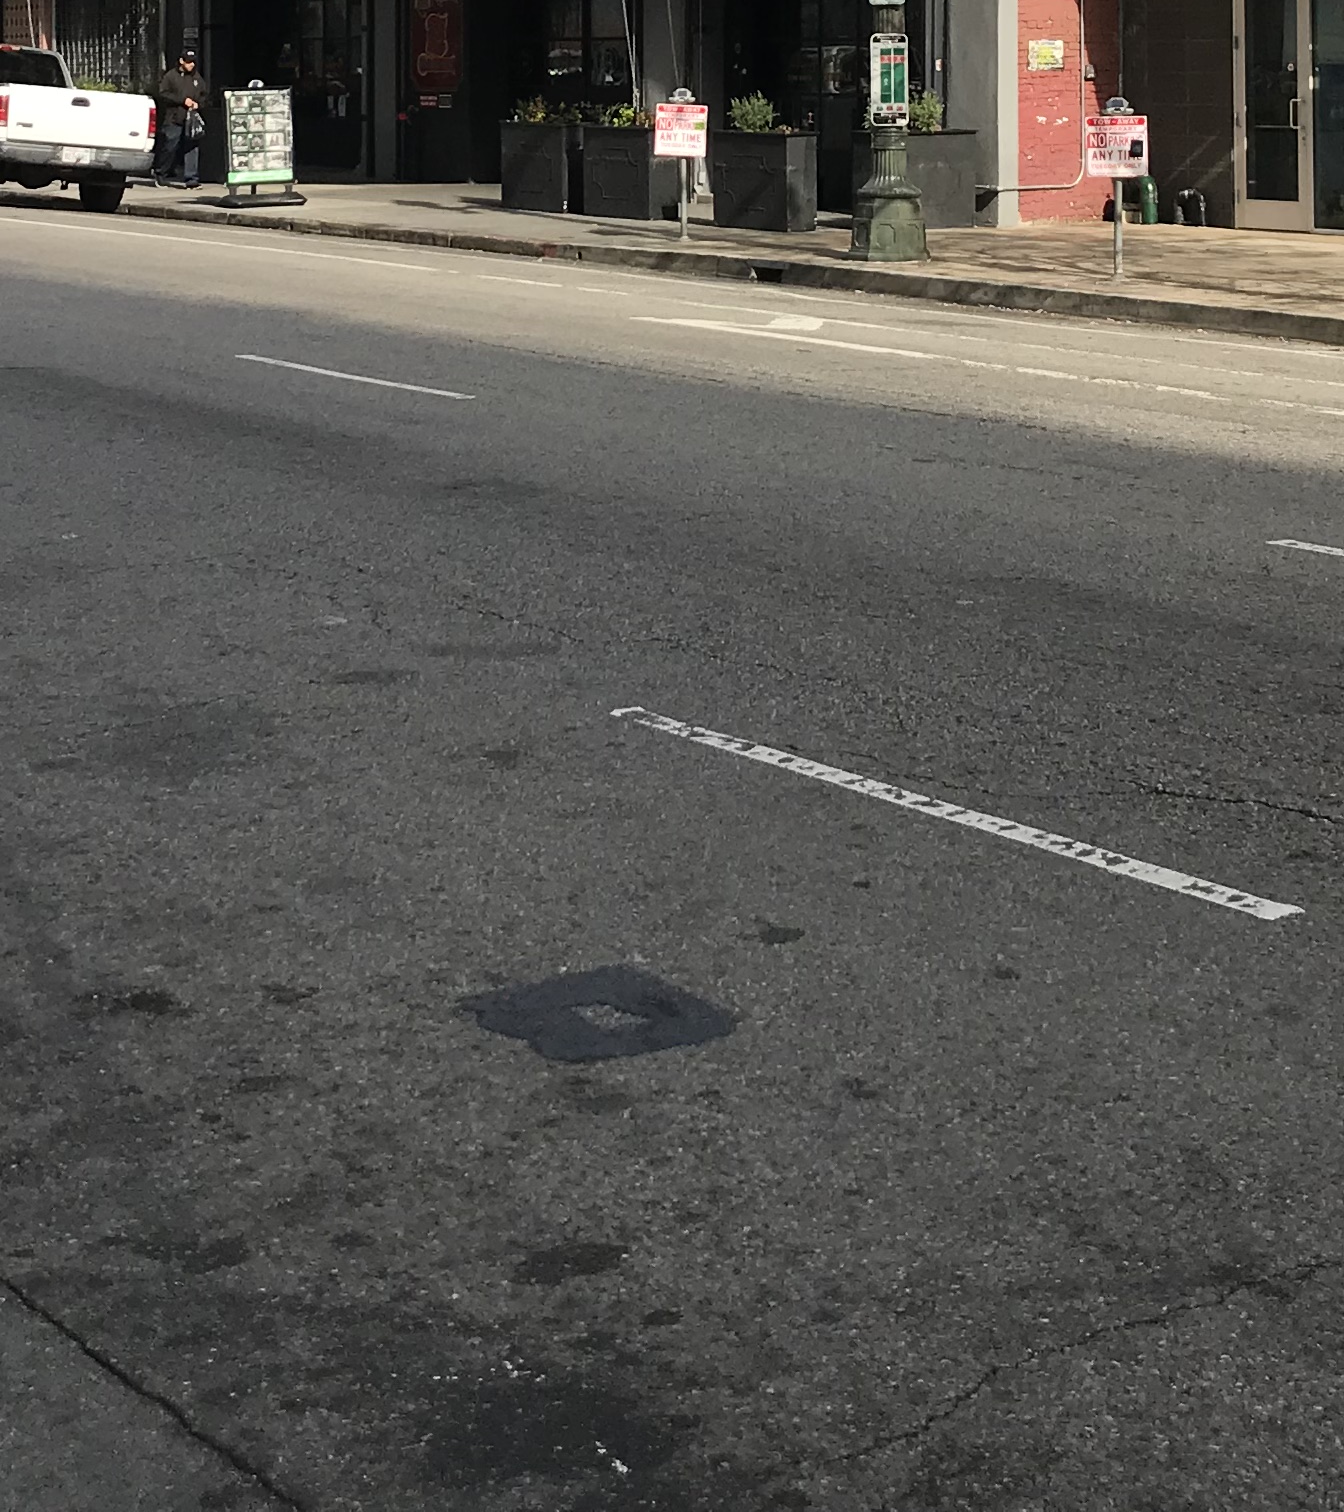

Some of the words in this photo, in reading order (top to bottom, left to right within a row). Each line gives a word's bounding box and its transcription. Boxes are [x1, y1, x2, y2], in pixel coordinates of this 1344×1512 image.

[658, 118, 673, 130] NO
[660, 132, 677, 141] ANY
[682, 134, 702, 142] TIME
[1089, 134, 1106, 148] NO
[1092, 150, 1113, 160] ANY
